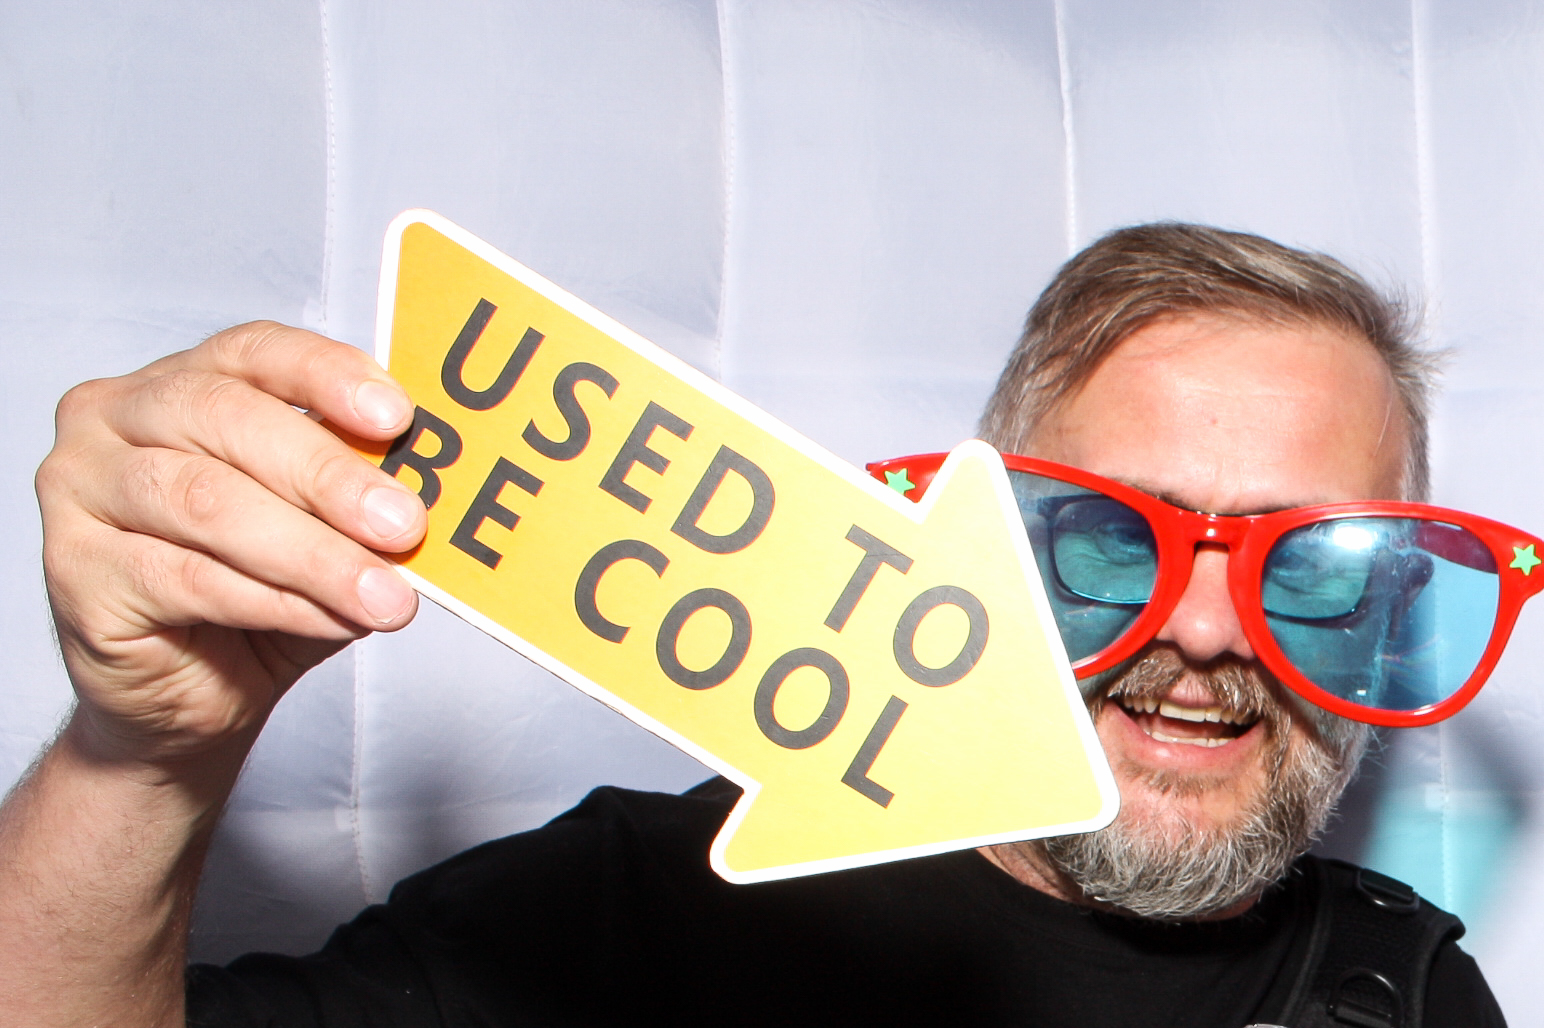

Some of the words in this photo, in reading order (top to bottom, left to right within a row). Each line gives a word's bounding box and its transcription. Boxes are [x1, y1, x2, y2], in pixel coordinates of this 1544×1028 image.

[381, 405, 545, 570] BE
[574, 539, 909, 809] COOL
[441, 297, 776, 554] USED
[824, 524, 990, 687] TO
